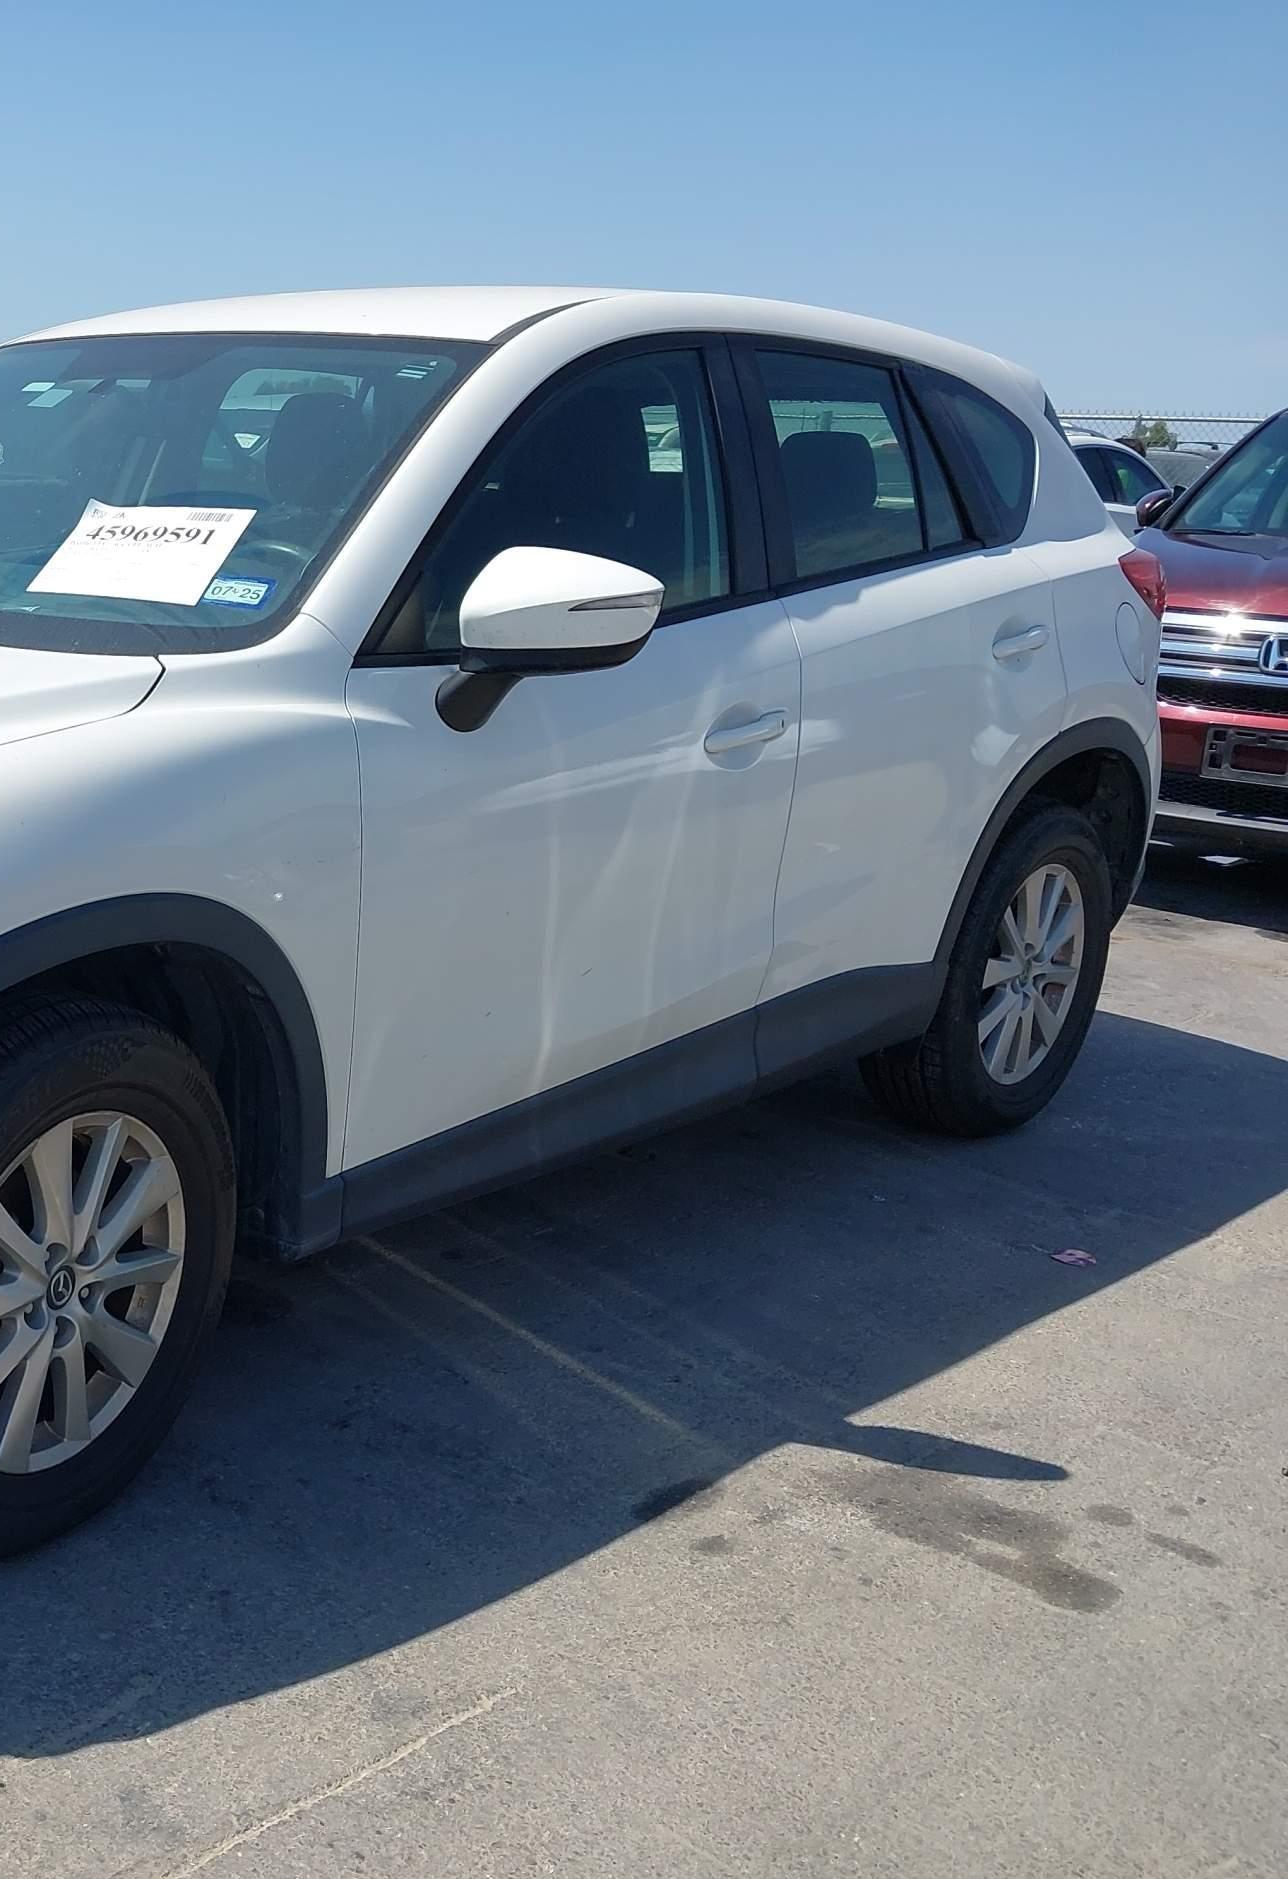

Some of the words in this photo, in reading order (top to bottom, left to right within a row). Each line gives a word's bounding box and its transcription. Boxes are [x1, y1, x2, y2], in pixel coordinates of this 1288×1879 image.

[85, 524, 216, 545] 45969591
[211, 586, 234, 596] 07
[238, 587, 263, 600] 25
